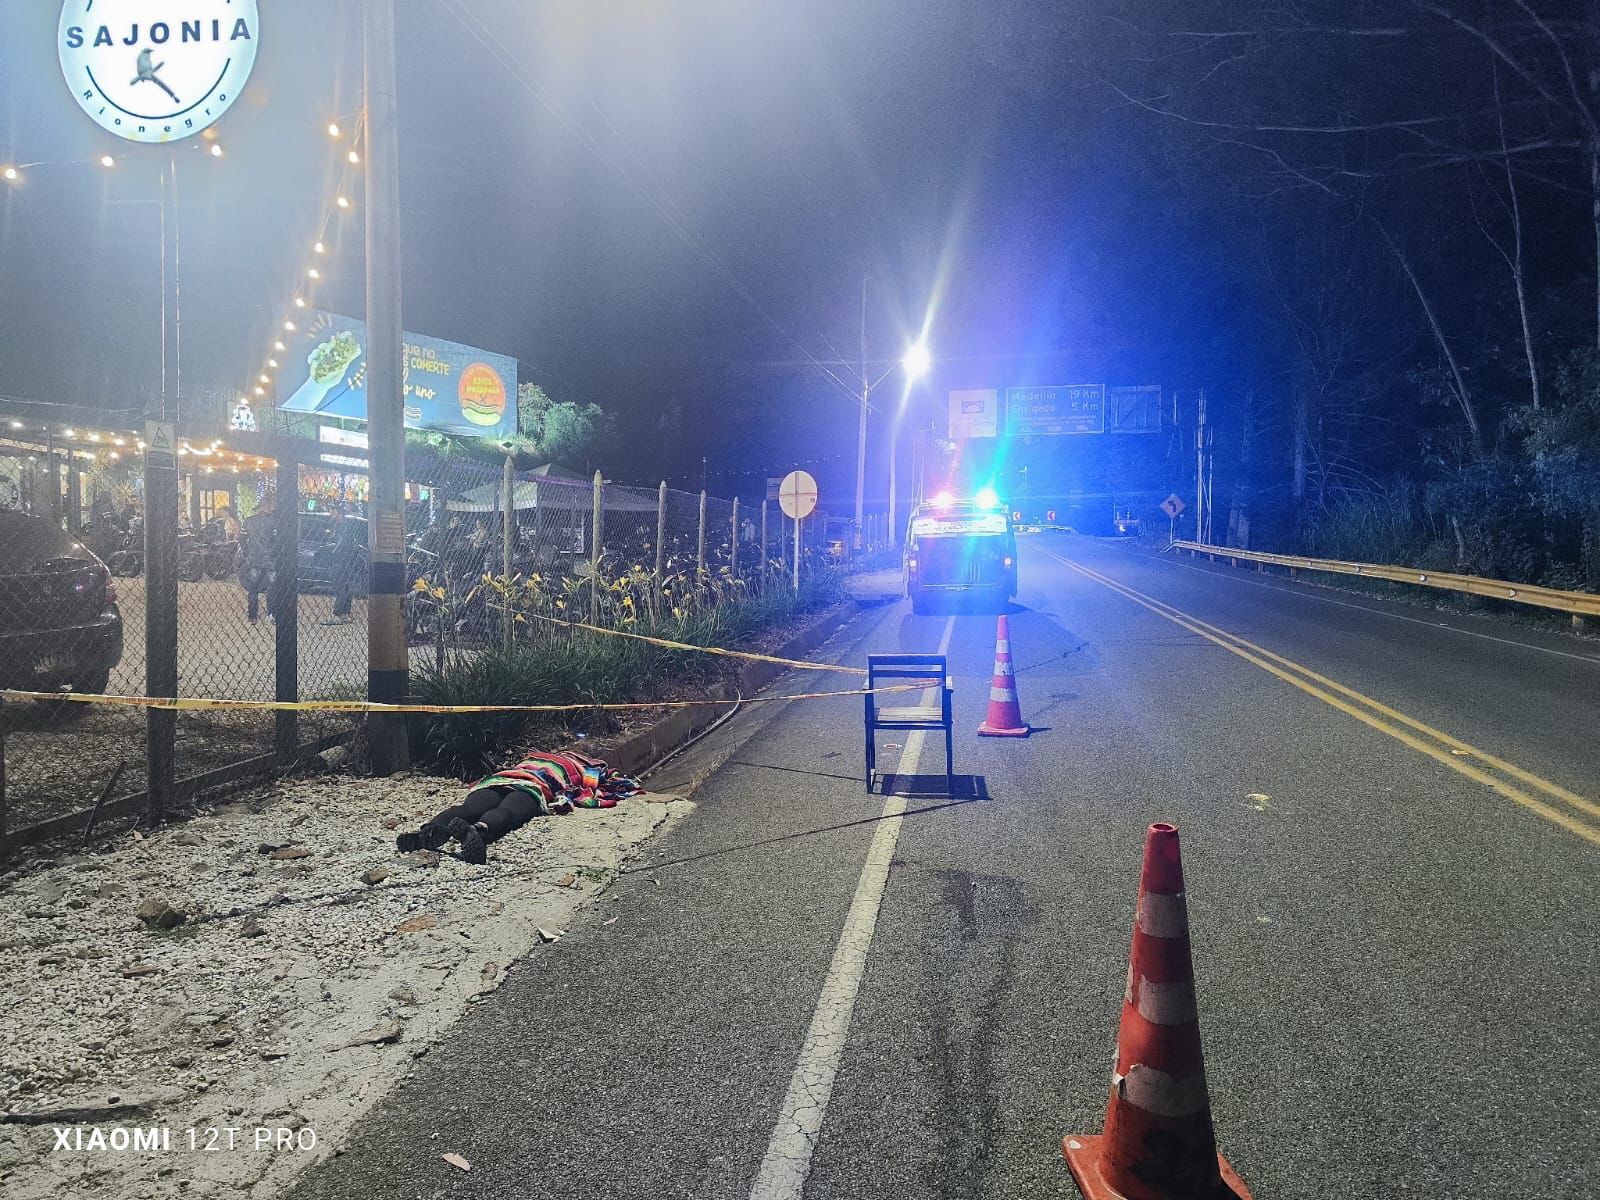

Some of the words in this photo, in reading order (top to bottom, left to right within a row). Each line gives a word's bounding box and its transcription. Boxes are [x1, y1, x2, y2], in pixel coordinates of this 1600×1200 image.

[66, 18, 251, 48] SAJONIA
[83, 89, 226, 133] Rionegro
[1069, 389, 1080, 399] 19
[1083, 389, 1099, 399] Km
[1012, 404, 1056, 415] Envigado
[1071, 402, 1078, 412] 5
[1082, 401, 1099, 411] Km
